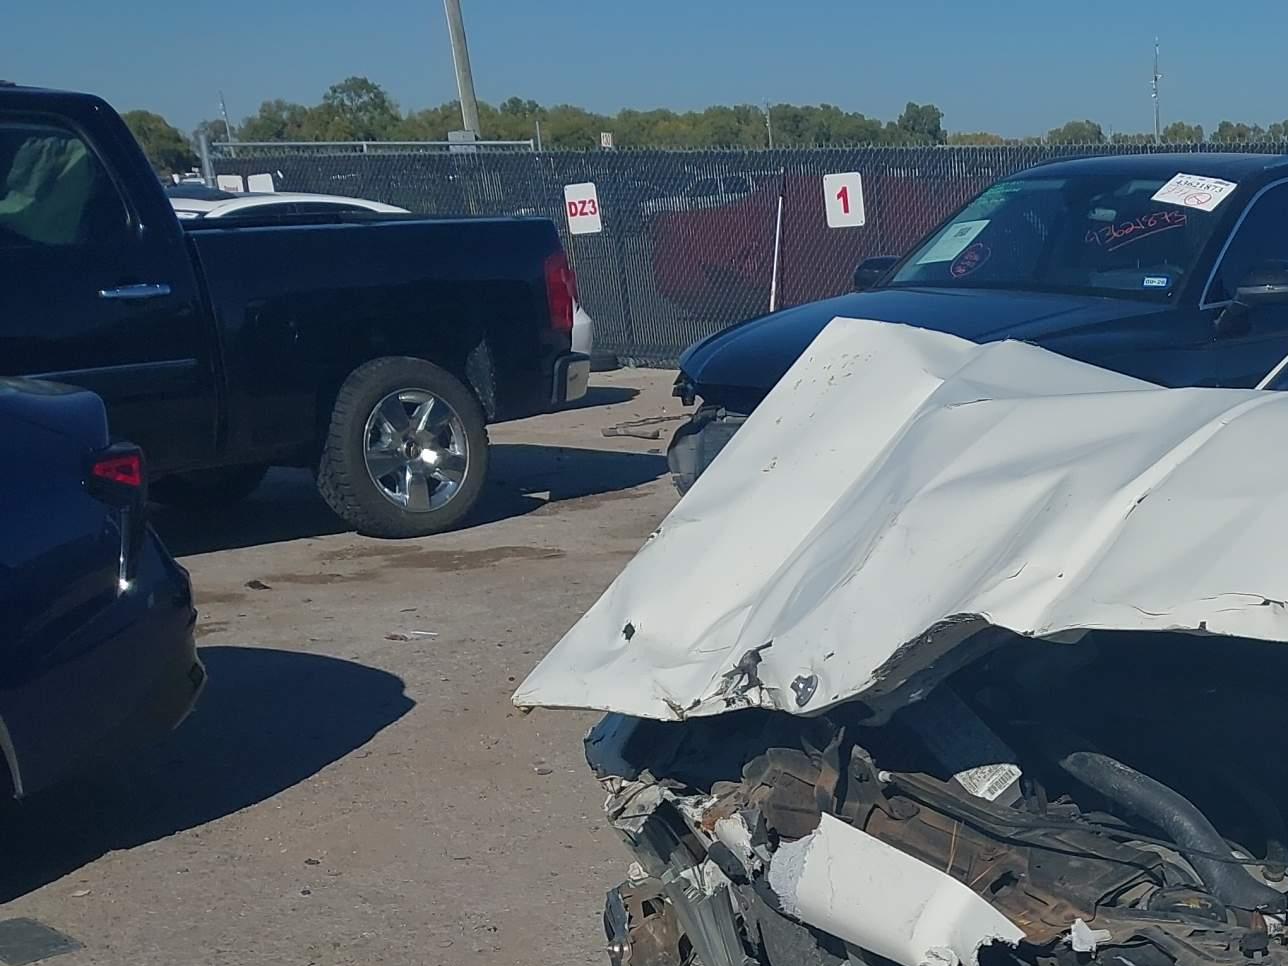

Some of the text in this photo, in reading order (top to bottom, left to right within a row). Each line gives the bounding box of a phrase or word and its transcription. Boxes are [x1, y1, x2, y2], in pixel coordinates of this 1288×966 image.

[1176, 179, 1224, 193] 43621873
[569, 200, 598, 218] DZ3
[836, 187, 850, 214] 1
